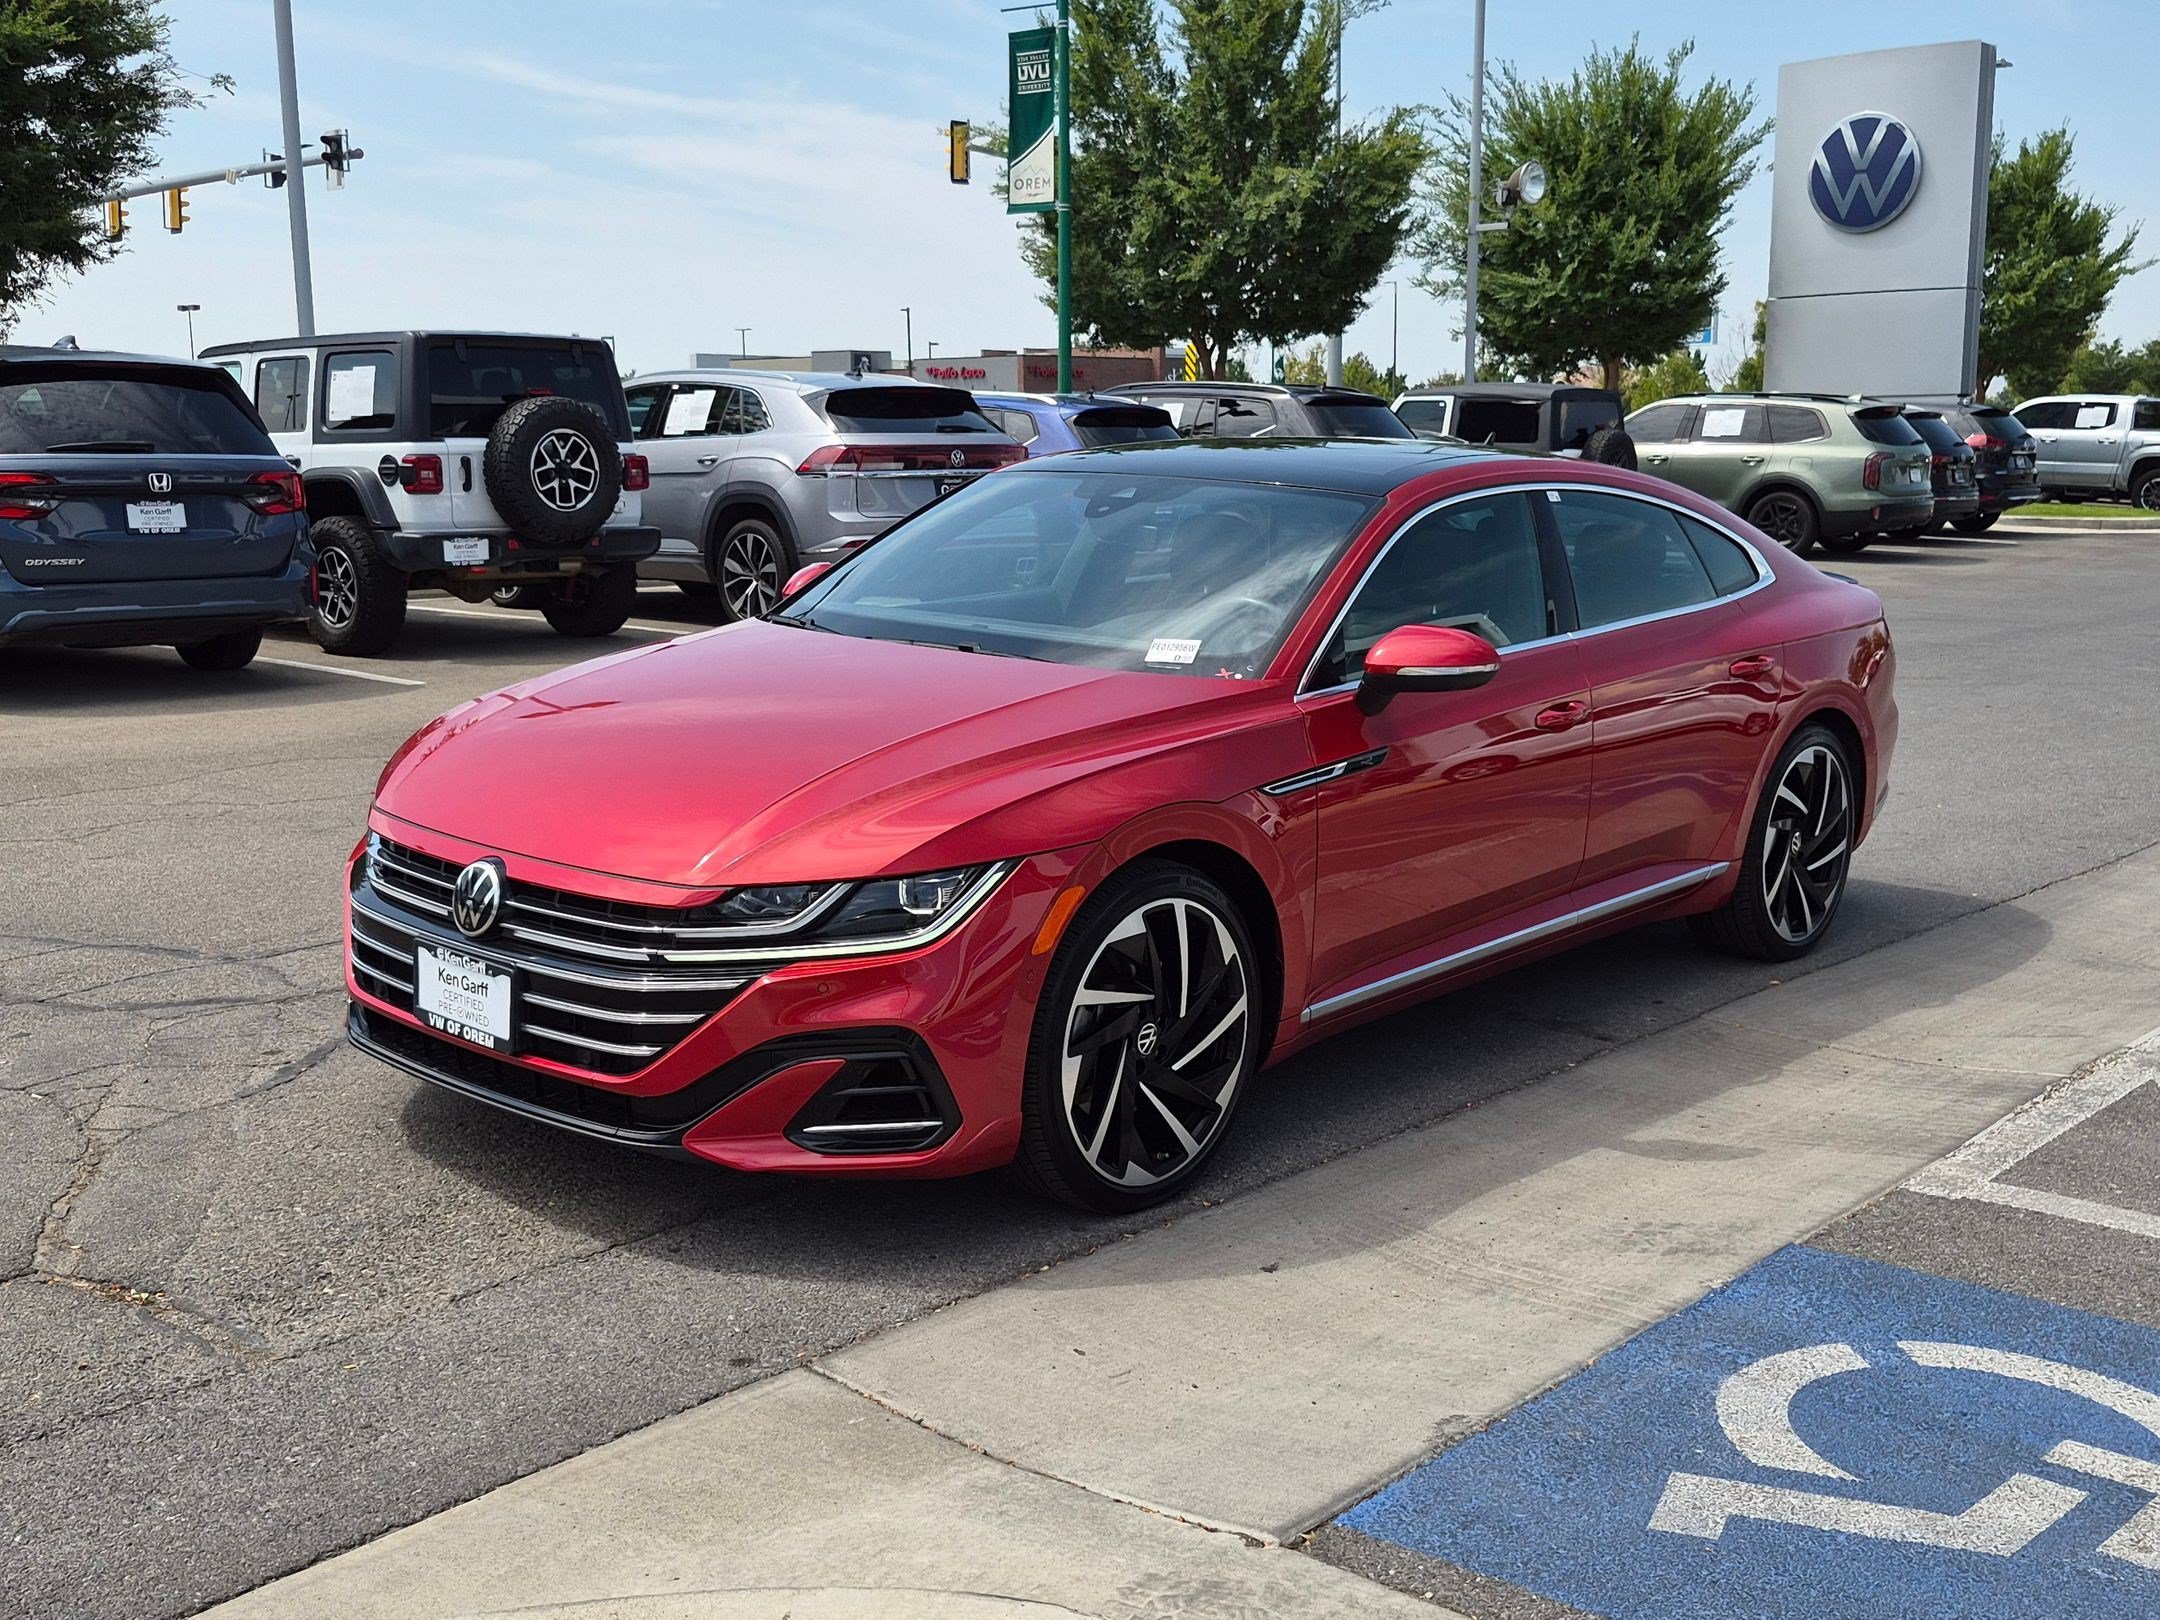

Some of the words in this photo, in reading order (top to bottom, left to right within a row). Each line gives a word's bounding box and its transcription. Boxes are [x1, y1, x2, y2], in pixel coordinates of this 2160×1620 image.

[1018, 62, 1050, 81] UVU
[1018, 82, 1050, 91] UNIVERSITY
[1014, 177, 1051, 190] OREM
[25, 558, 86, 566] ODYSSEY
[445, 949, 463, 968] Ken
[462, 956, 487, 976] Garff
[438, 966, 459, 988] Ken
[461, 975, 489, 998] Garff
[443, 988, 485, 1012] CERTIFIED
[428, 1012, 445, 1030] VW
[446, 1019, 462, 1036] OF
[463, 1025, 495, 1049] OREM
